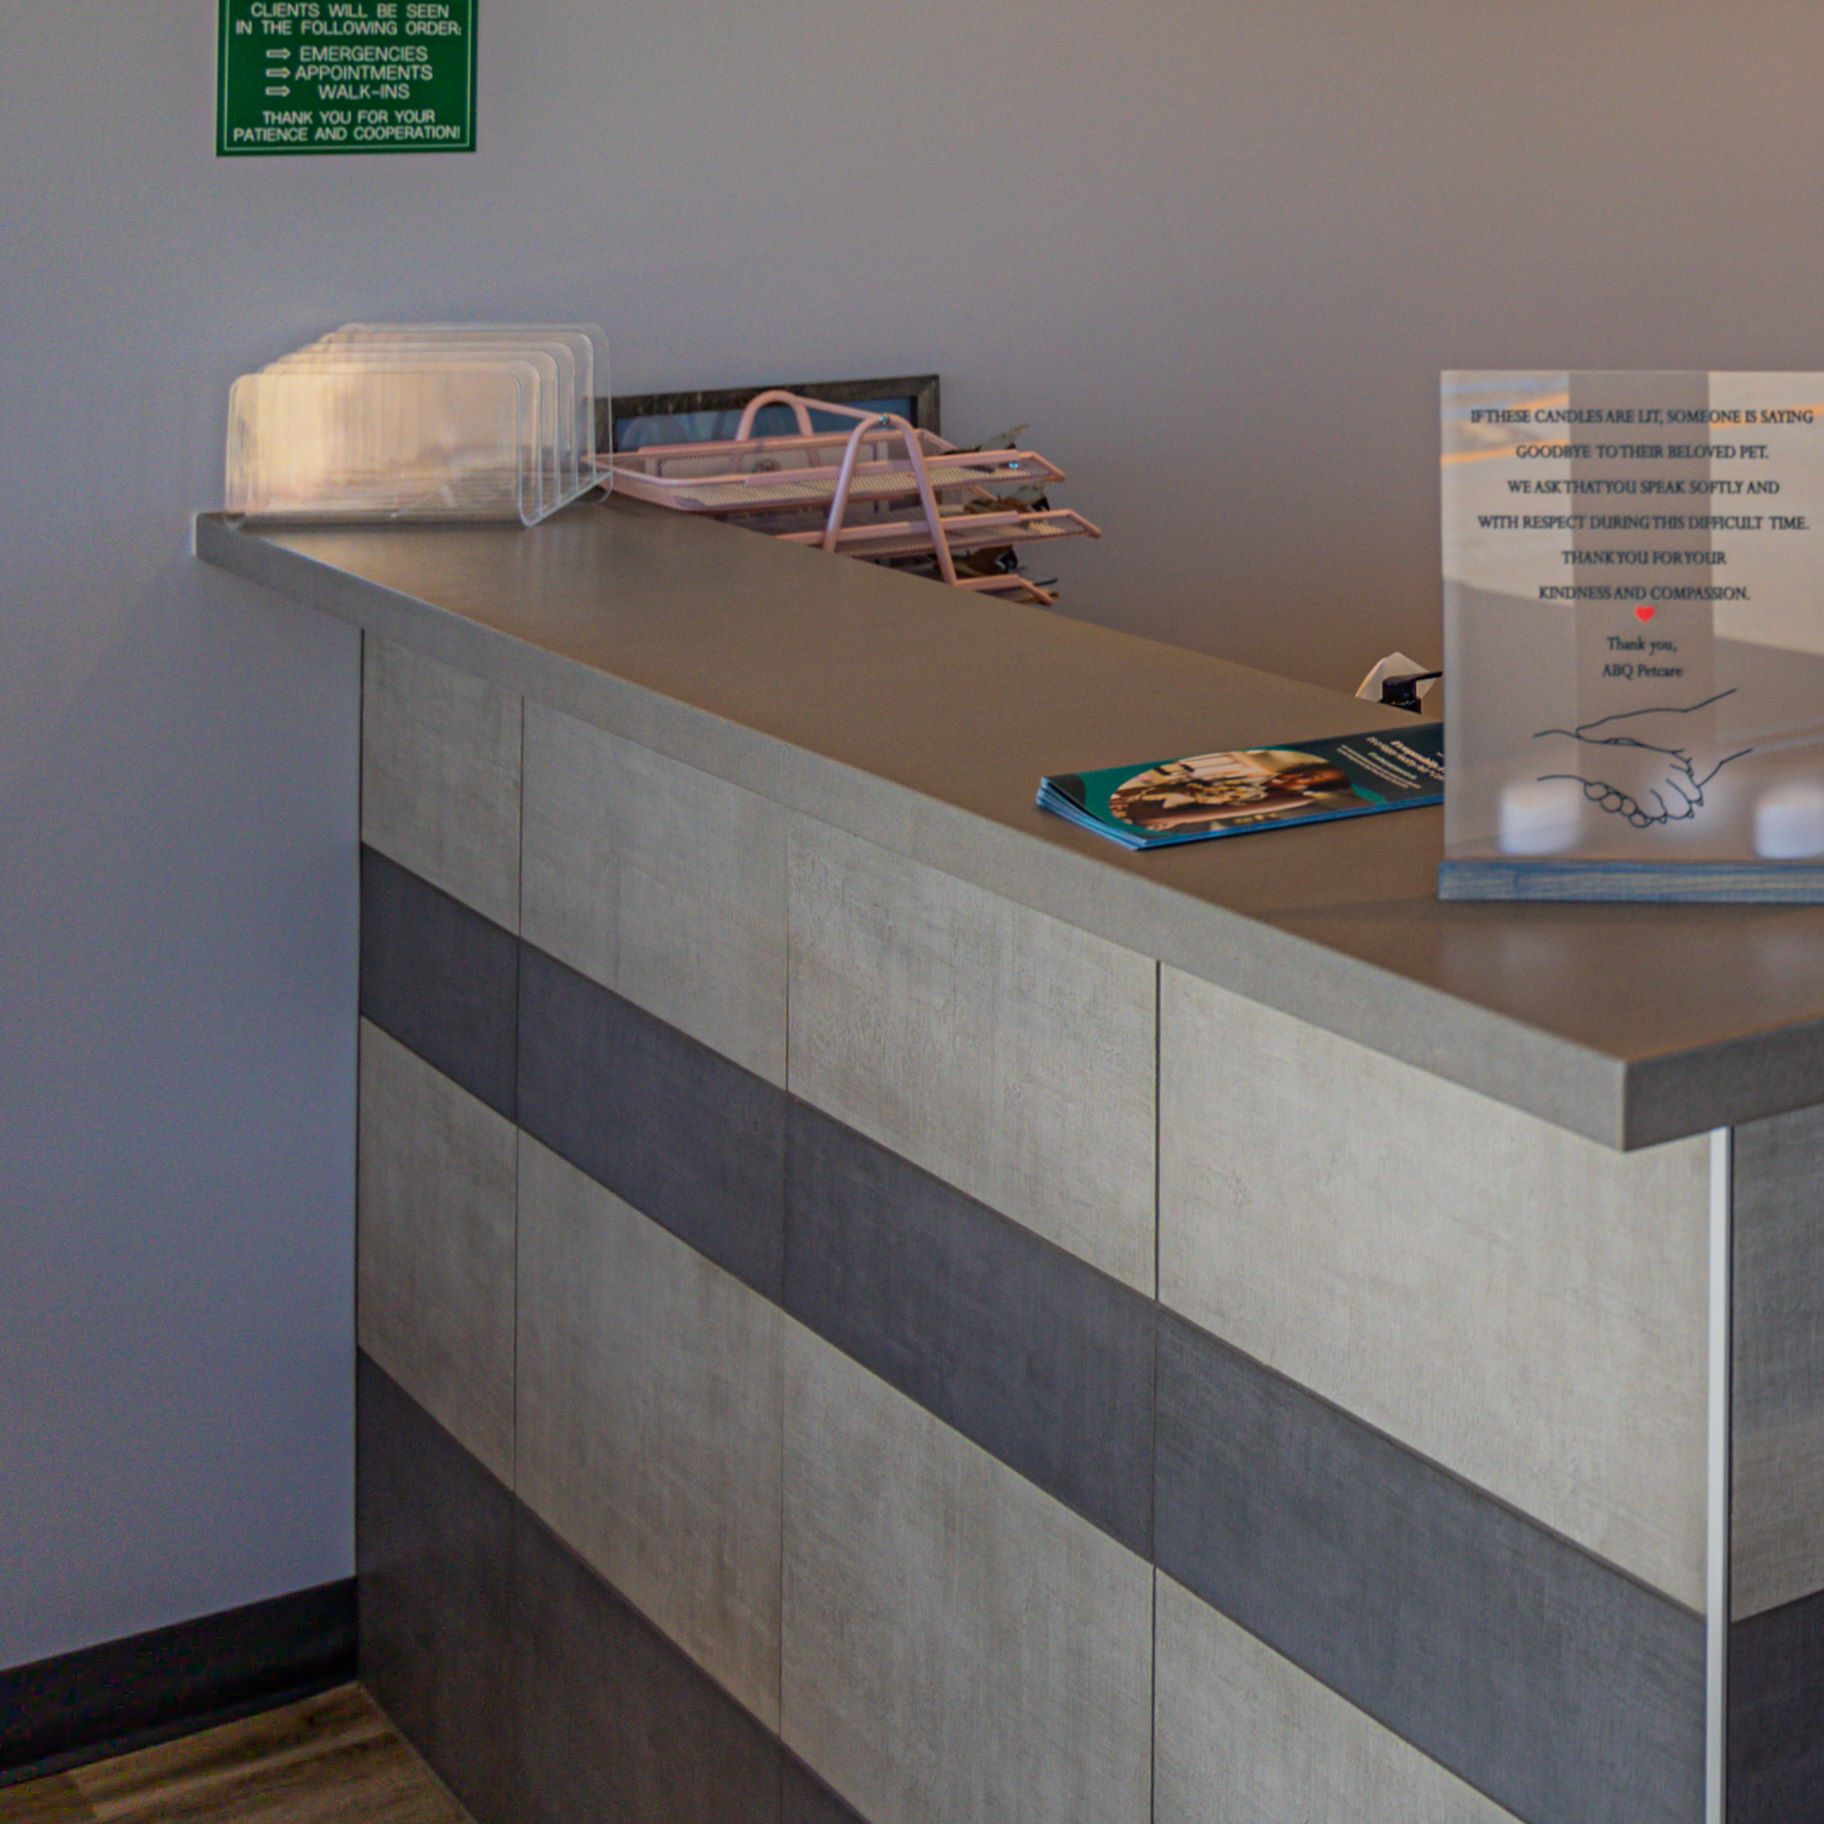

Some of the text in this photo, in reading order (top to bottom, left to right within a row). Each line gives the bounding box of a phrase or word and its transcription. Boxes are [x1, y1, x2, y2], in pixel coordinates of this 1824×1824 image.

[251, 2, 450, 18] CLIENTS WILL BE SEEN
[235, 20, 253, 35] IN
[261, 20, 293, 35] THE
[302, 20, 398, 36] FOLLOWING
[300, 45, 428, 62] EMERGENCIES
[295, 64, 433, 81] APPOINTMENTS
[318, 83, 410, 100] WALK-INS
[262, 109, 436, 125] THANK YOU FOR YOUR
[233, 125, 461, 142] PATIENCE AND COOPERATION!
[1486, 409, 1531, 424] THESE
[1534, 409, 1604, 424] CANDLES
[1605, 409, 1634, 424] ARE
[1638, 409, 1664, 426] LIT,
[1667, 409, 1741, 424] SOMEONE
[1744, 410, 1758, 424] IS
[1761, 410, 1814, 424] SAYING
[1516, 444, 1770, 460] GOODBYE TO THEIR BELOVED PET.
[1507, 480, 1780, 495] WE ASK THAT YOU SPEAK SOFTLY AND
[1477, 515, 1811, 531] WITH RESPECT DURING THIS DIFFICULT TIME.
[1561, 550, 1727, 565] THANK YOU FOR YOUR
[1538, 586, 1751, 601] KINDNESS AND COMPASSION.
[1606, 636, 1678, 656] Thank you,
[1602, 664, 1683, 680] ABQ Petcare
